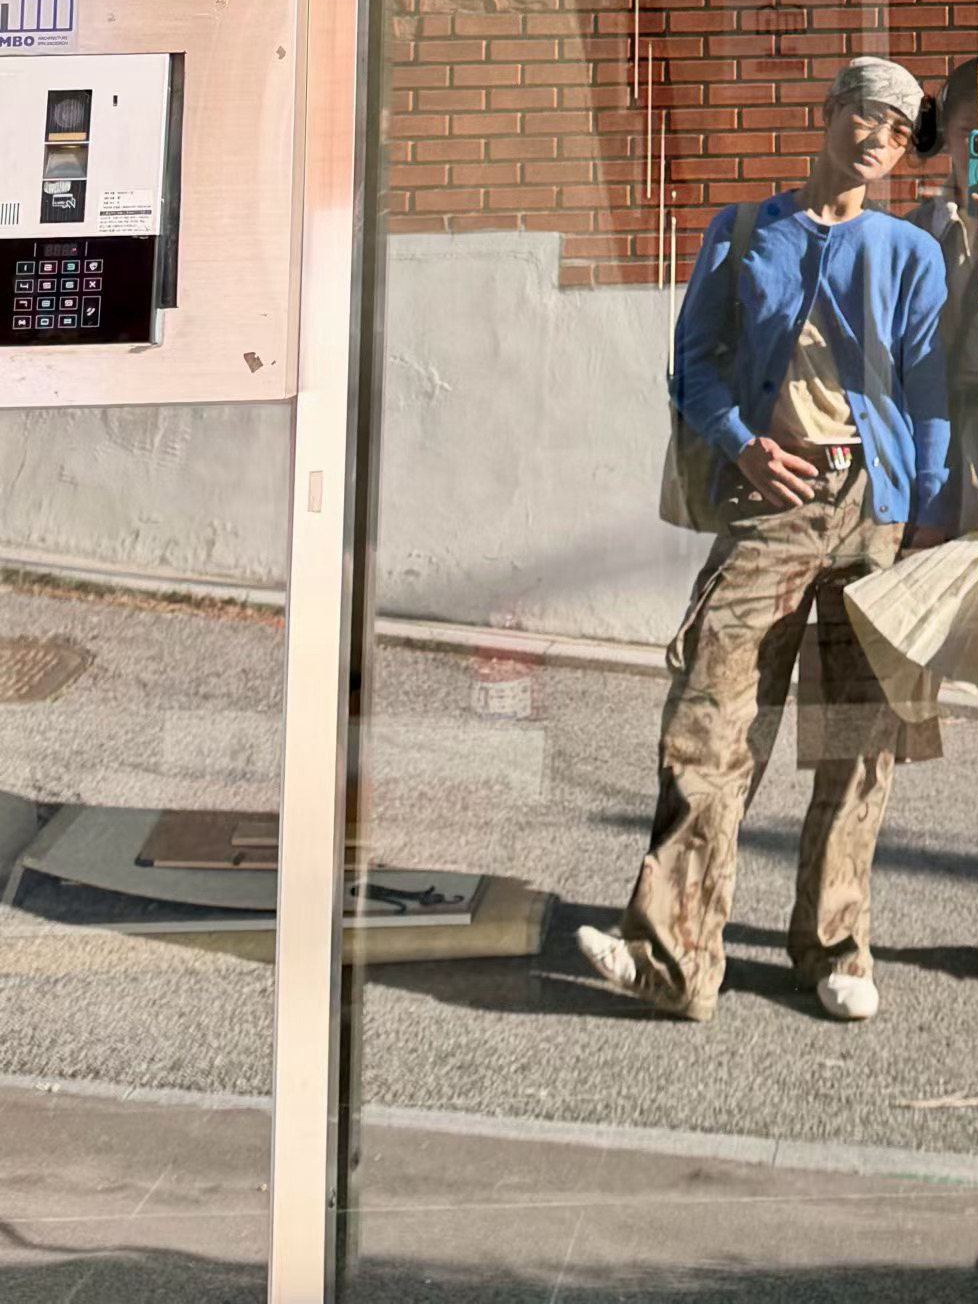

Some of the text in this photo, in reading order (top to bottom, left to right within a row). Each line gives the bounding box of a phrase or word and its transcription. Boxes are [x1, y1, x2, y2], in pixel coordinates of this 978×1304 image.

[43, 263, 53, 272] 2
[67, 263, 76, 271] 3
[40, 318, 50, 326] 0
